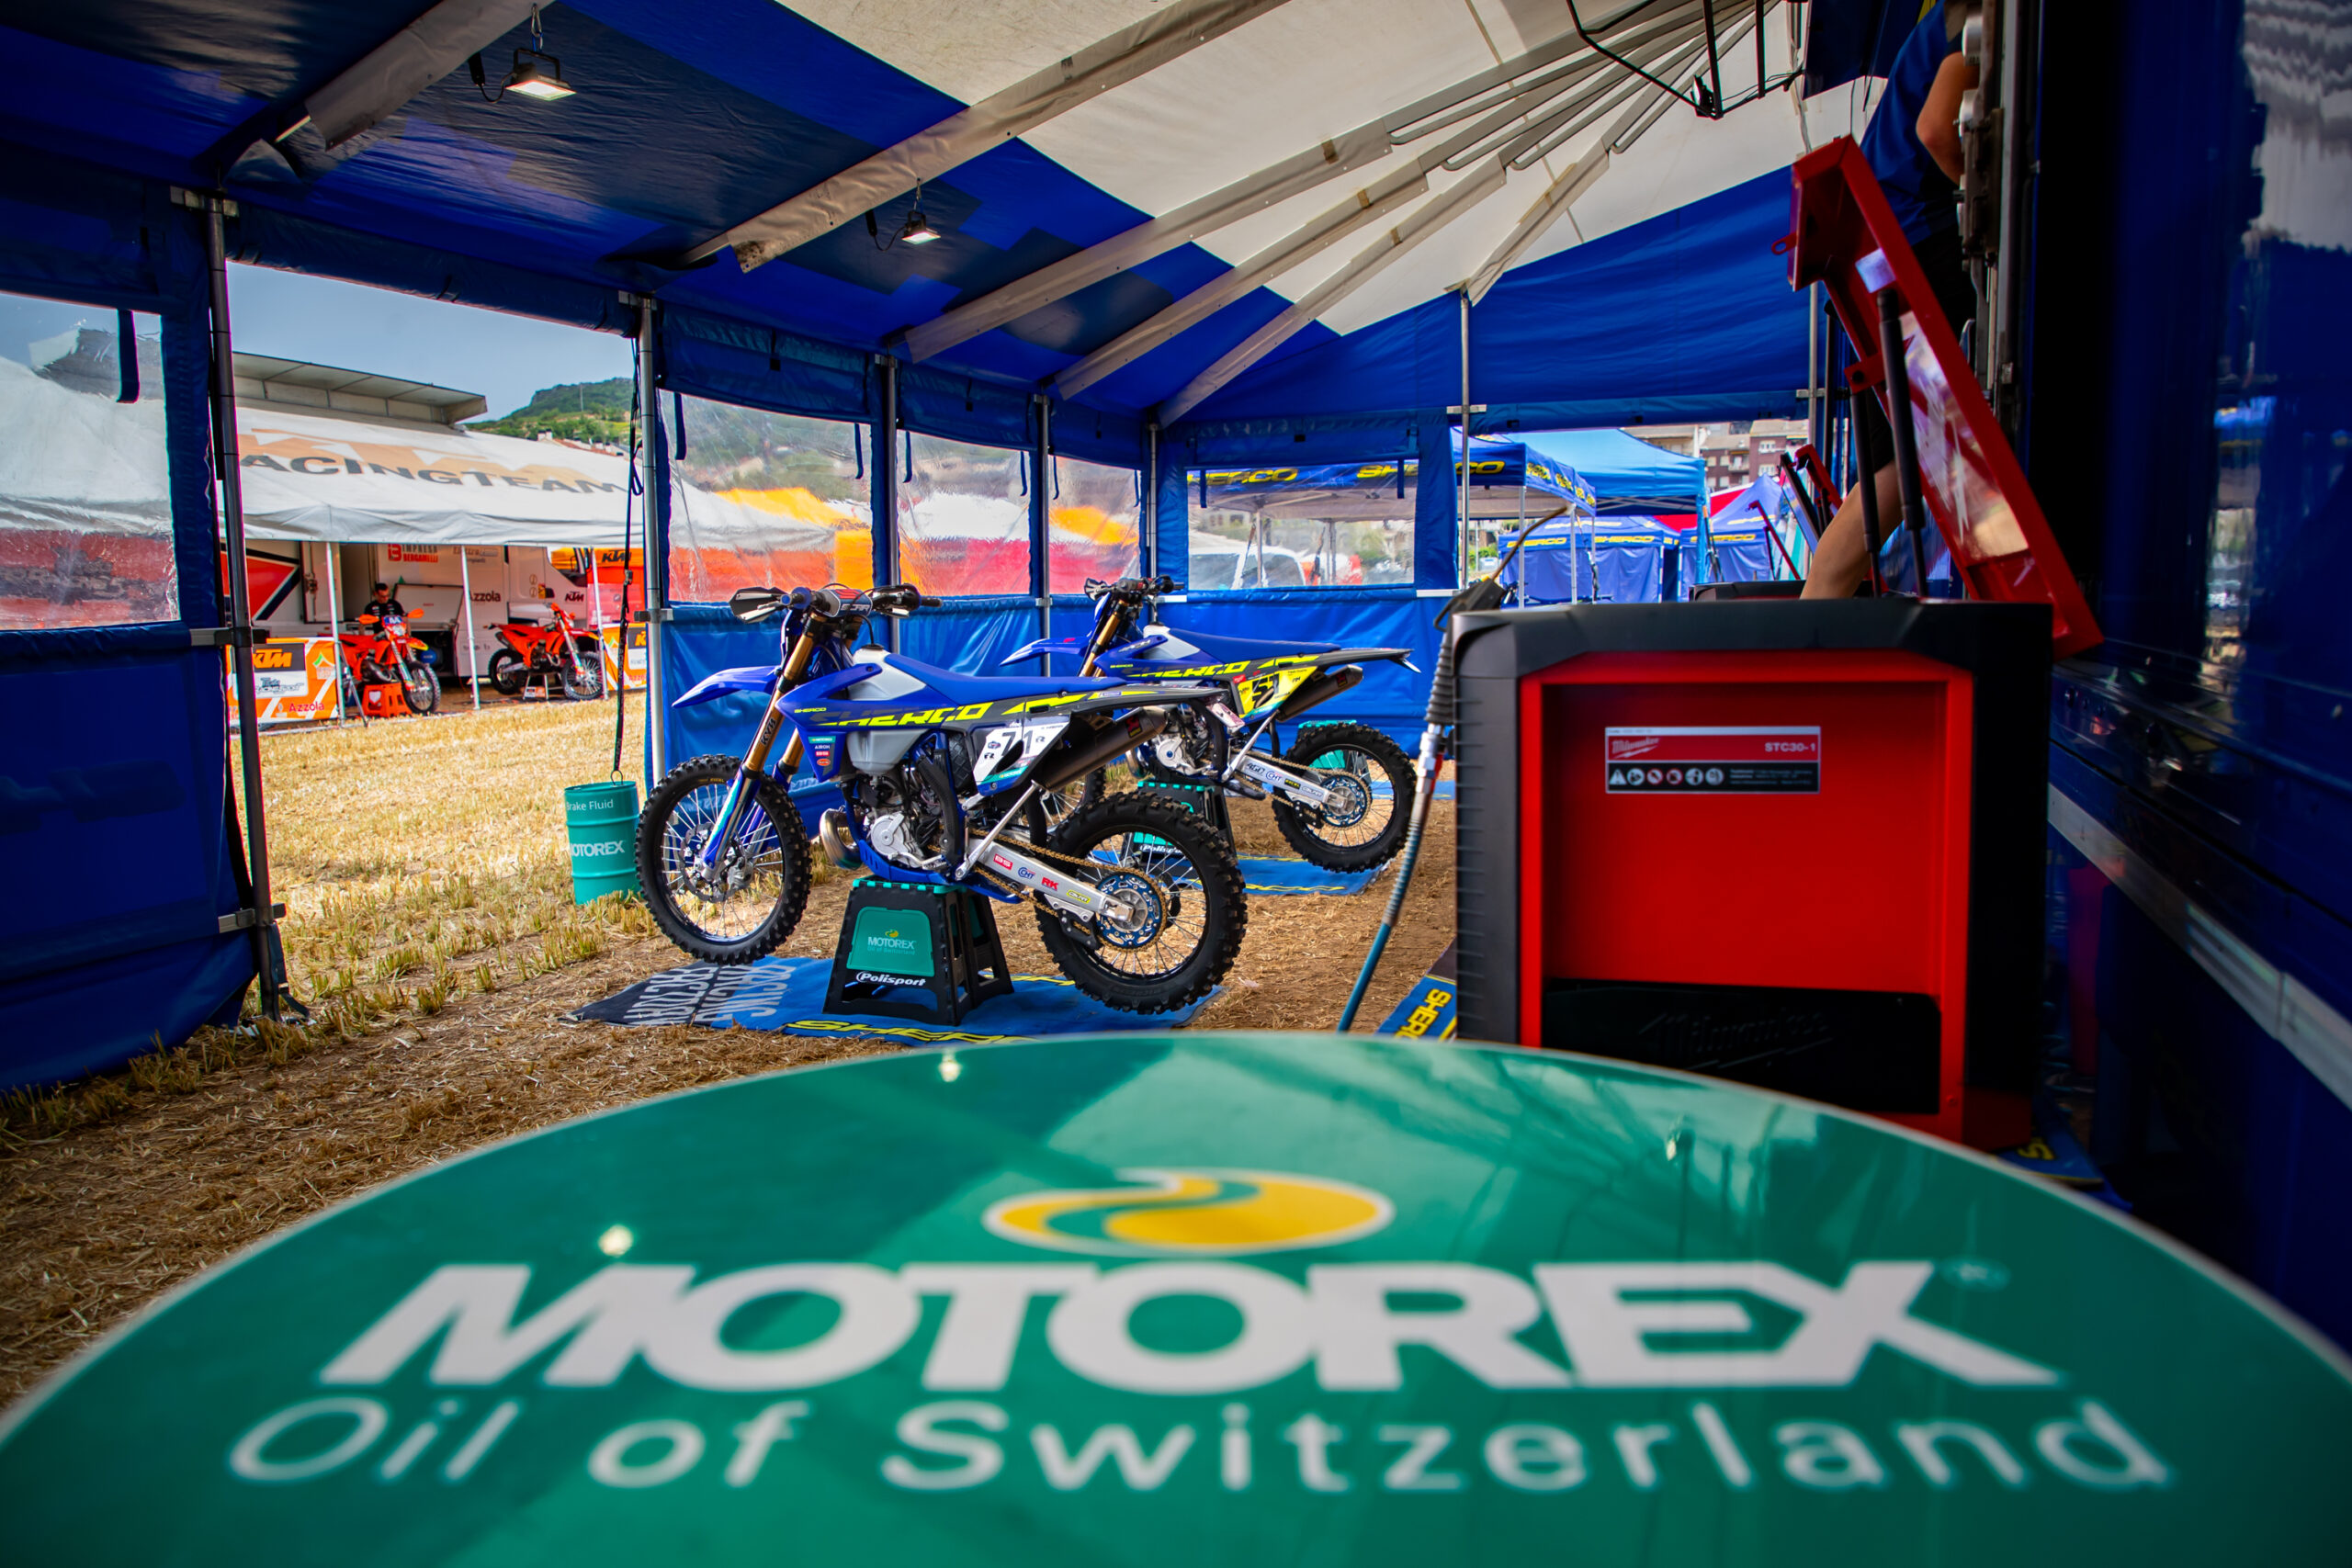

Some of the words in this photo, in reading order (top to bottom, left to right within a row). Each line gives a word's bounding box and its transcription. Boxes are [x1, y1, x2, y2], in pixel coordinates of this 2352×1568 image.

[240, 455, 628, 494] ACINGTEAM
[565, 592, 584, 602] KTM
[253, 649, 292, 669] KTM
[288, 701, 324, 712] Azzola
[1765, 742, 1816, 751] STC30-1
[589, 799, 614, 809] Fluid
[570, 840, 625, 856] OTOREX
[1041, 876, 1058, 890] RK
[868, 936, 915, 949] MOTOREX
[861, 973, 926, 986] Polisport
[318, 1261, 2069, 1393] MOTOREX
[228, 1397, 520, 1484] Oil
[588, 1402, 812, 1488] of
[882, 1398, 2174, 1494] Switzerland
